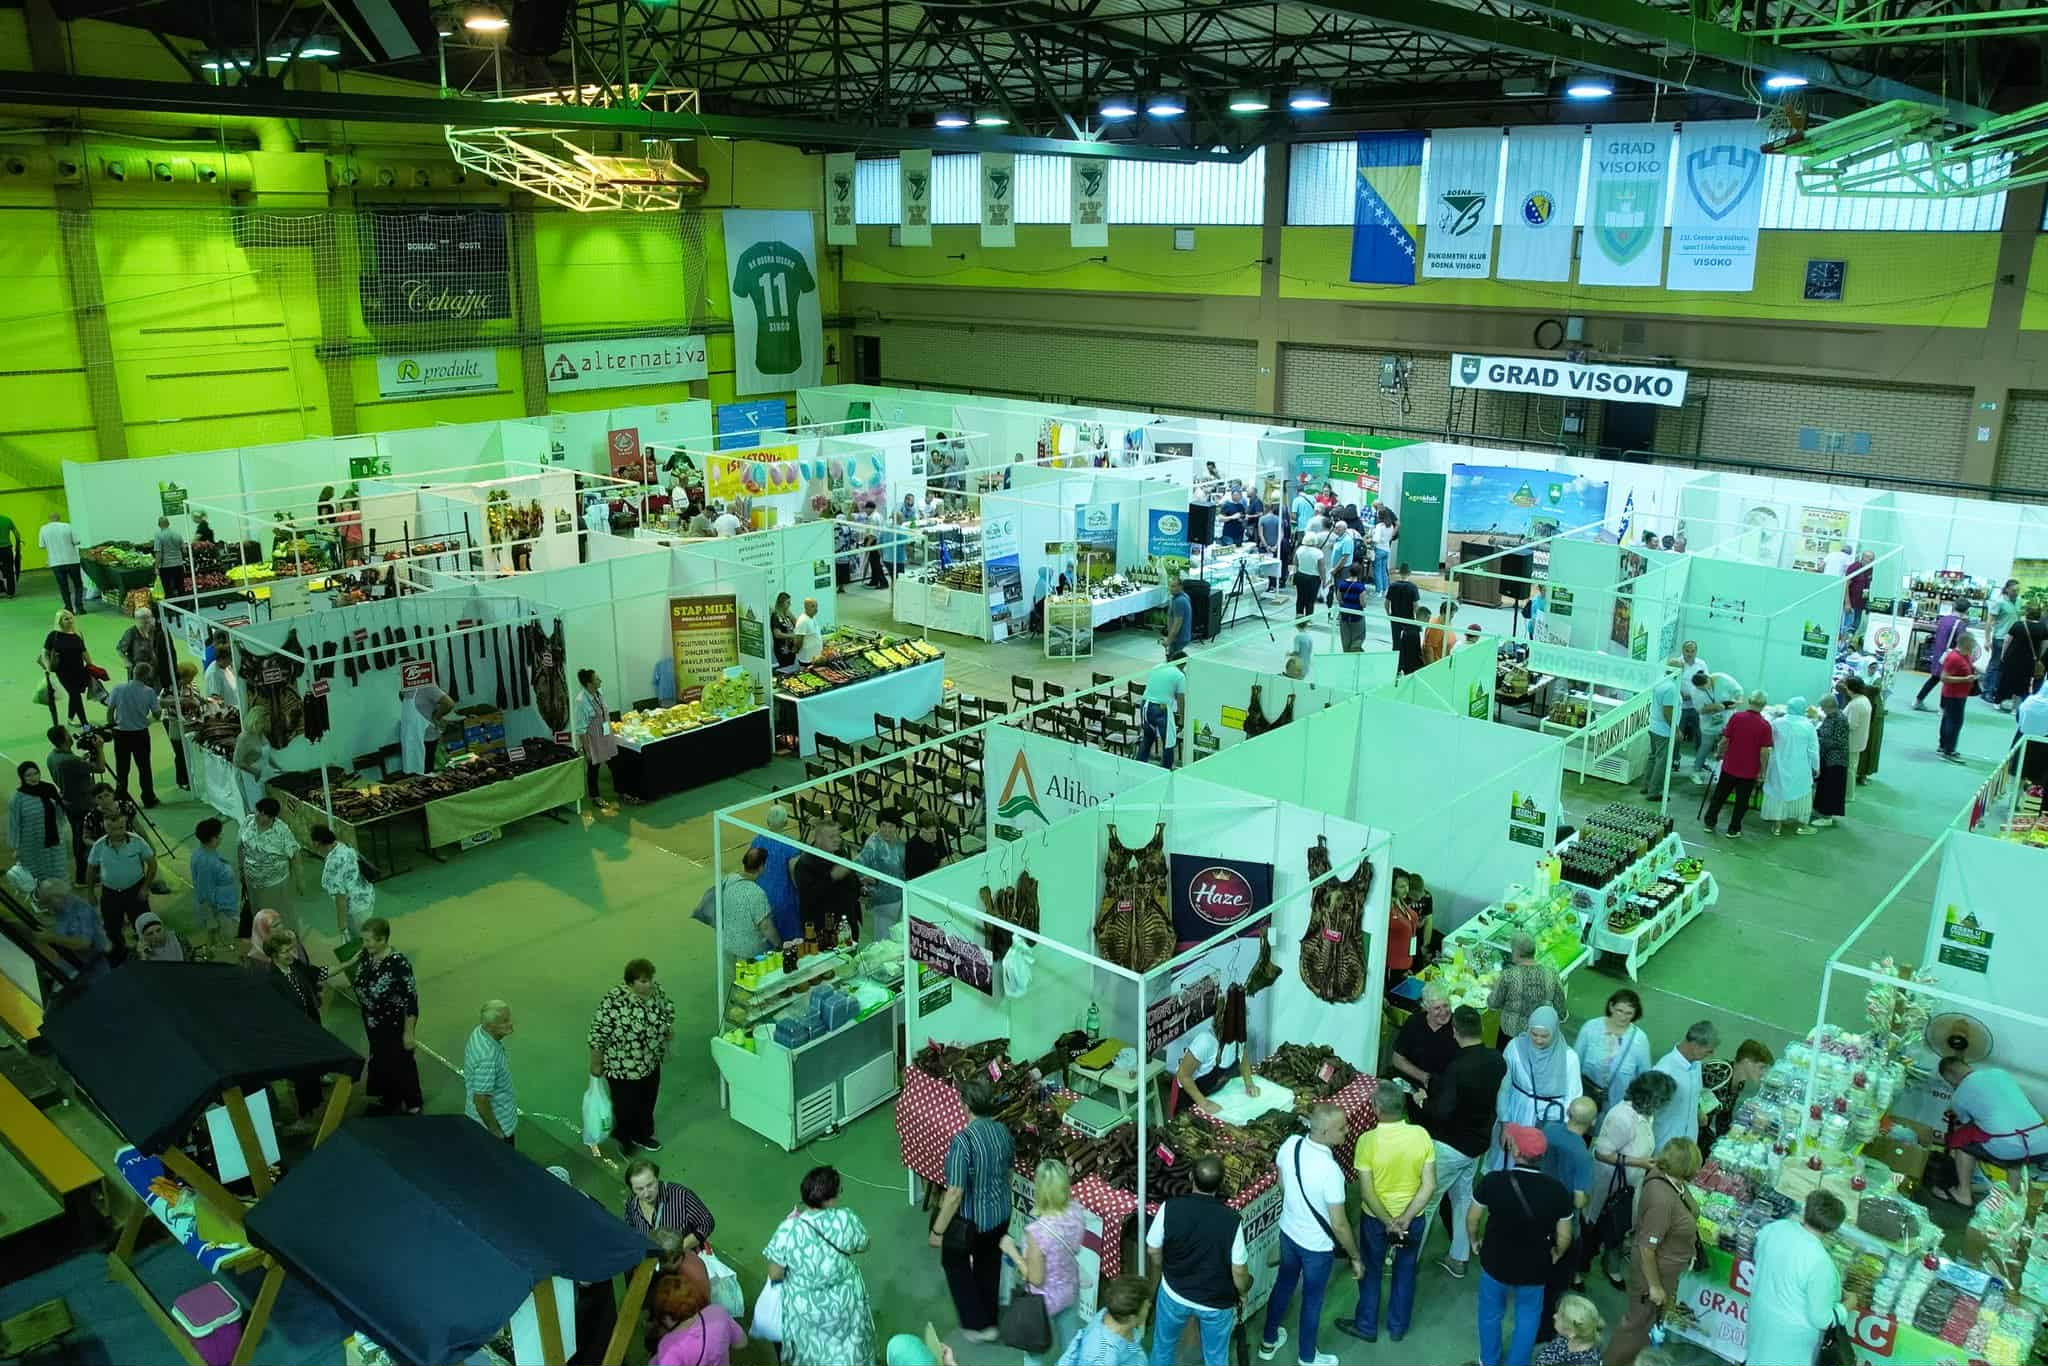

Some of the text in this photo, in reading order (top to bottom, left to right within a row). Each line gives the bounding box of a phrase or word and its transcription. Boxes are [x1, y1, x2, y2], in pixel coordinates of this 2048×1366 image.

[1608, 142, 1656, 155] GRAD
[1600, 160, 1661, 174] VISOKO
[1427, 252, 1487, 260] RUKOMETNI KLUB
[1693, 257, 1732, 266] VISOKO
[759, 272, 789, 317] 11
[581, 346, 705, 372] alternativa
[423, 360, 478, 385] produkt
[1488, 363, 1674, 398] GRAD VISOKO
[704, 603, 735, 614] MILK
[1046, 775, 1104, 809] Aliho
[1193, 882, 1249, 905] Haze
[1247, 1203, 1282, 1242] HAZE
